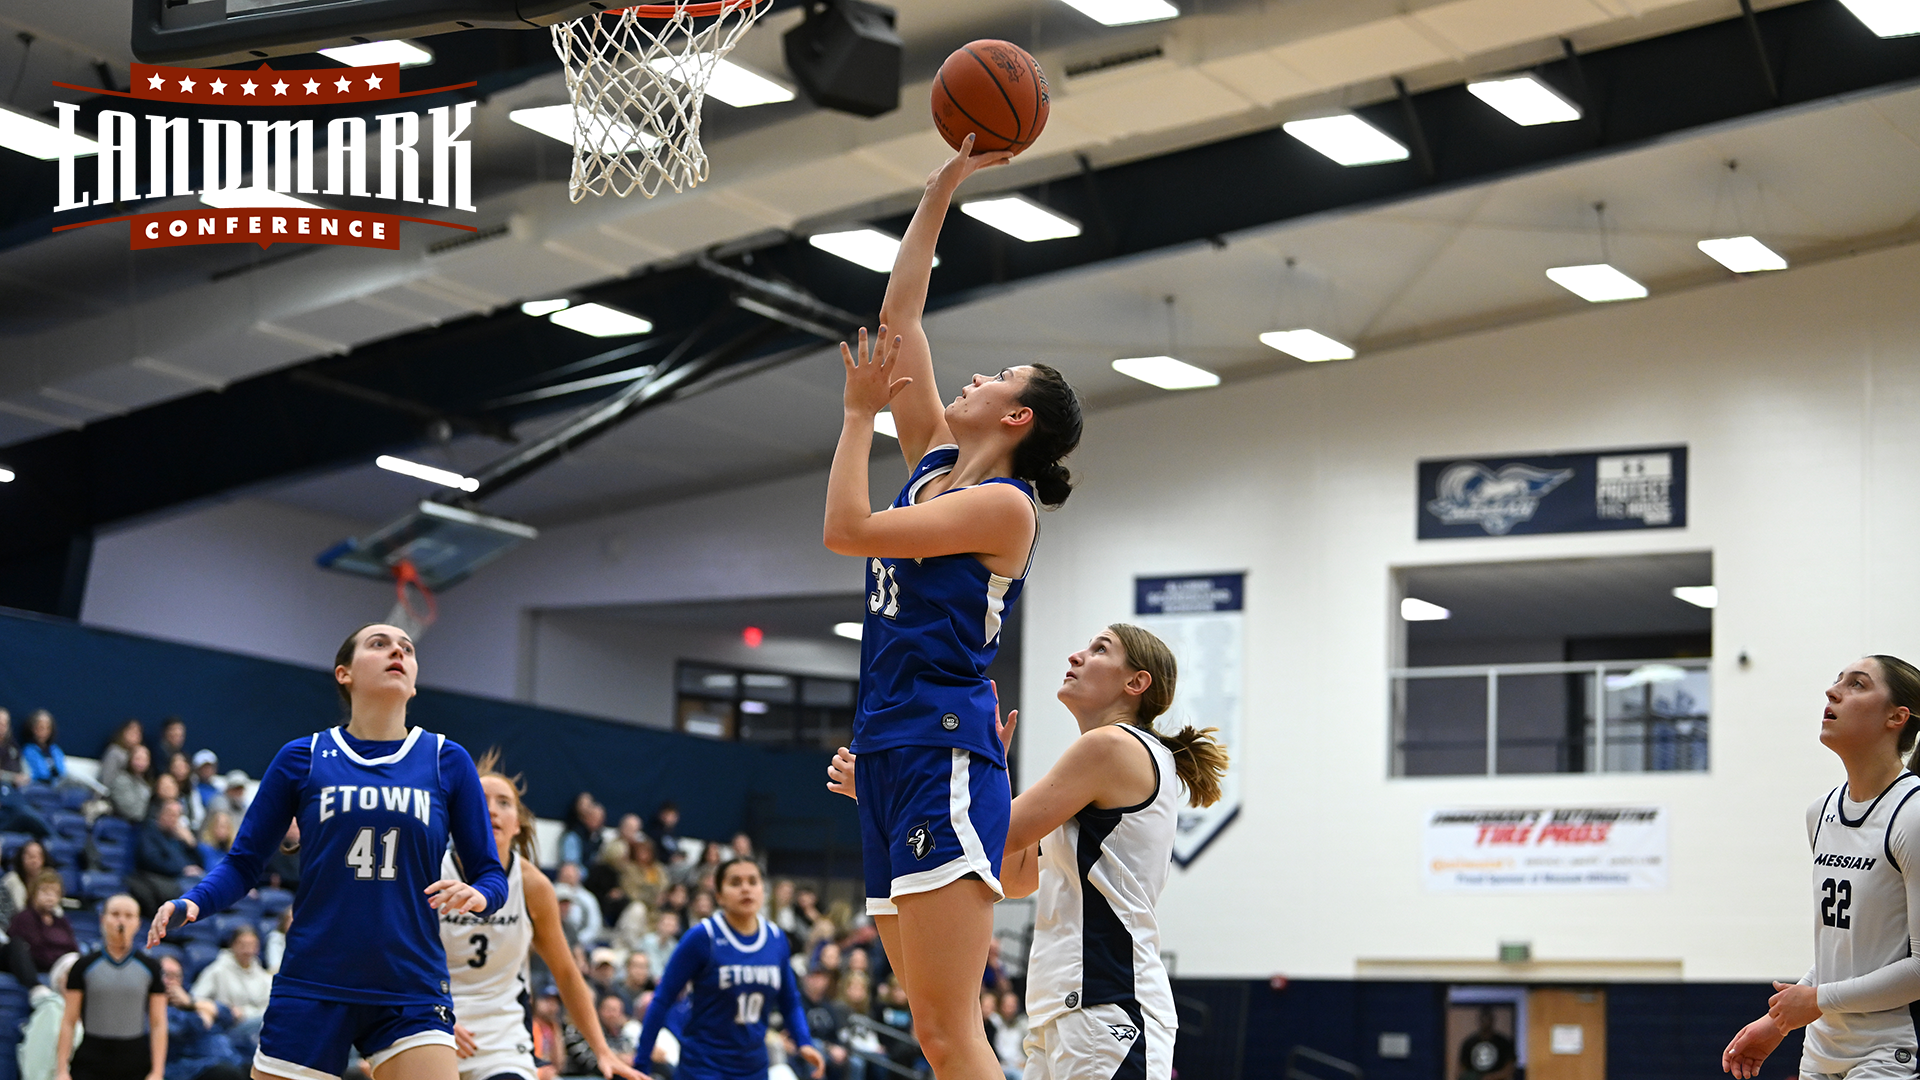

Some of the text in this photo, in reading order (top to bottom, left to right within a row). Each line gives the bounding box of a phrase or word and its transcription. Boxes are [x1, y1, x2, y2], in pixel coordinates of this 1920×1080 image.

[867, 556, 900, 620] 31
[319, 784, 431, 827] ETOWN
[345, 826, 400, 880] 41
[1814, 853, 1877, 871] MESSIAH
[1821, 877, 1852, 930] 22
[467, 933, 488, 969] 3
[718, 965, 782, 990] ETOWN
[734, 992, 765, 1024] 10
